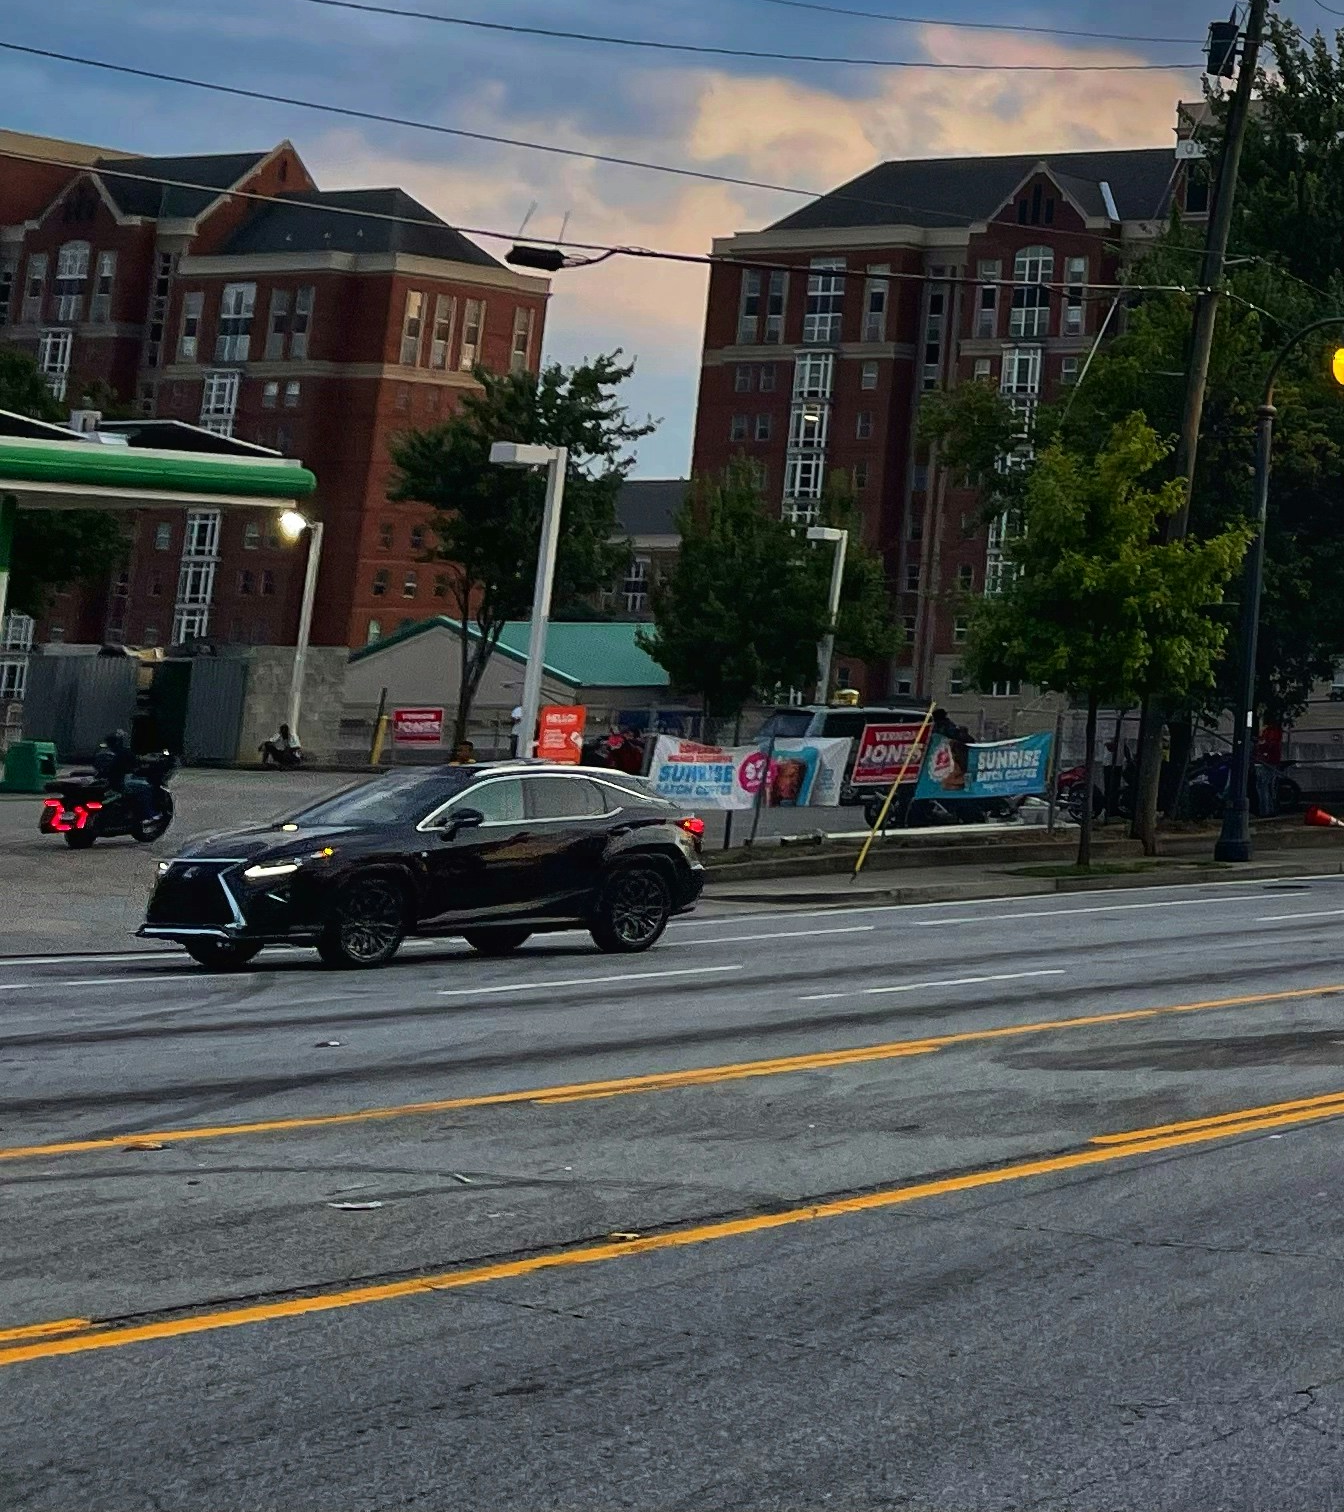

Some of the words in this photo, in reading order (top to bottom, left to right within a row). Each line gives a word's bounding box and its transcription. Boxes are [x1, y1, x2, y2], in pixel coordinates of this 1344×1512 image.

[860, 743, 924, 764] JONES
[977, 749, 1042, 770] SUNRISE
[658, 764, 735, 783] SUNRISE
